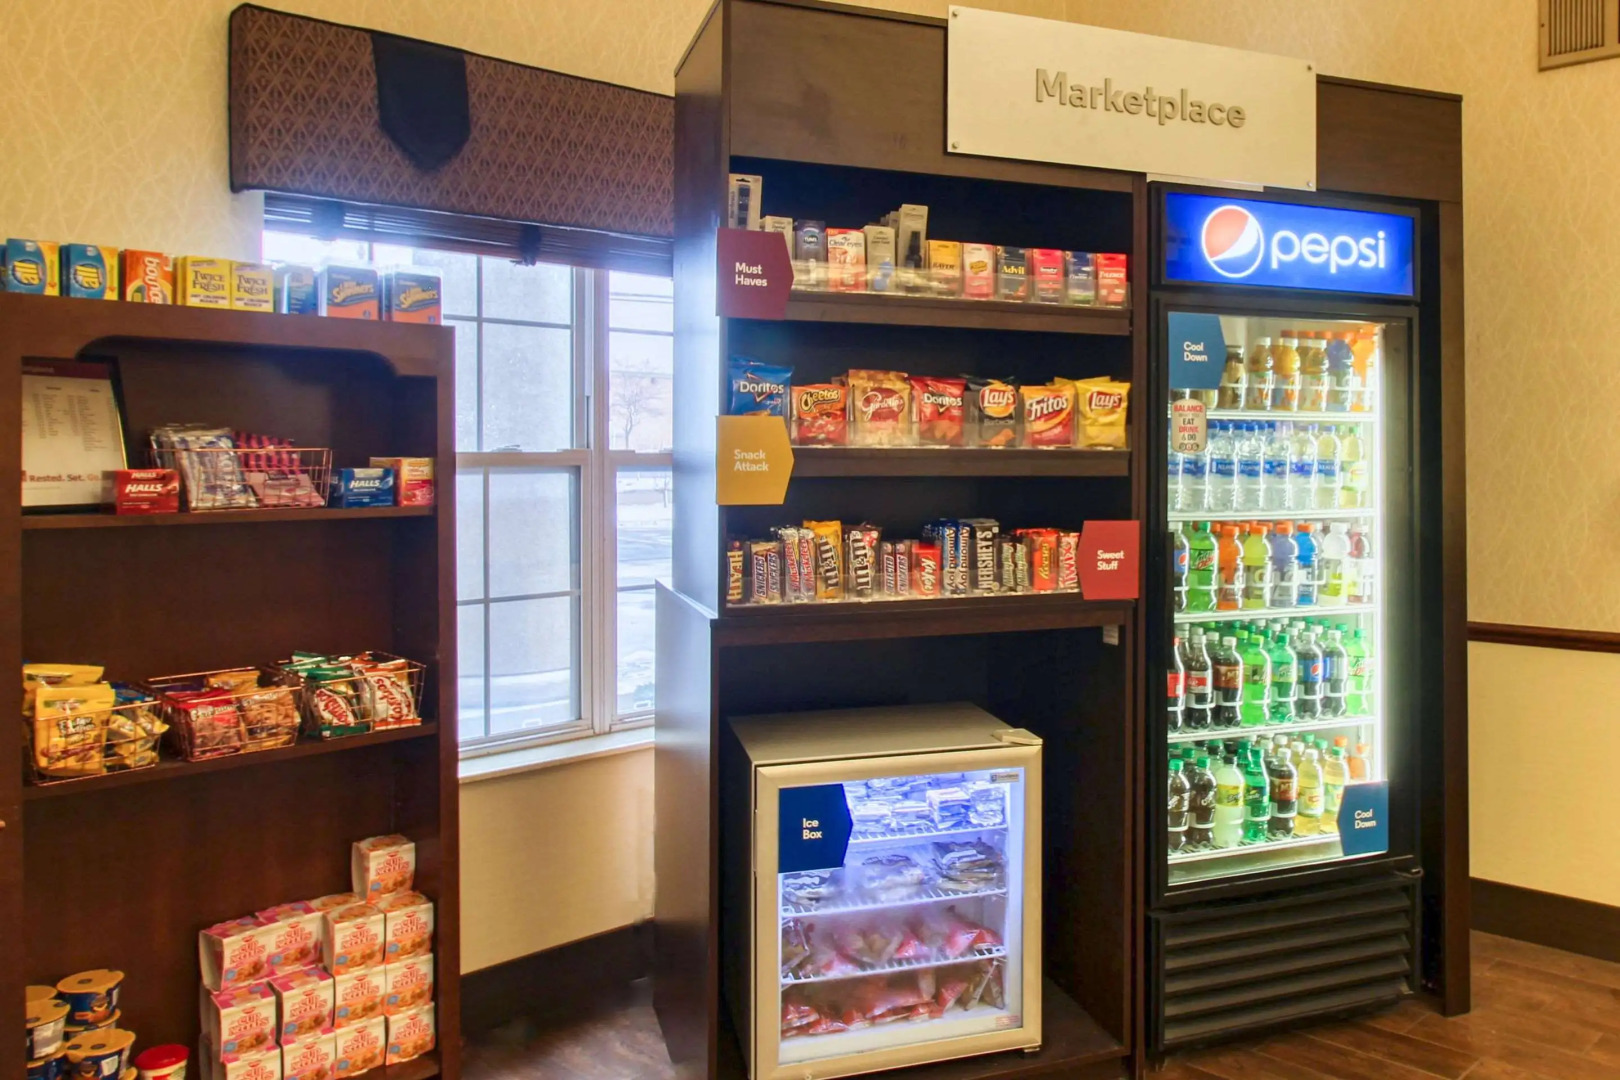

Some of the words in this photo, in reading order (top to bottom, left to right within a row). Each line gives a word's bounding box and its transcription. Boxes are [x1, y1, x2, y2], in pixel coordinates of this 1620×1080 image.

[1035, 67, 1247, 128] Marketplace
[829, 239, 845, 247] Clear
[1270, 229, 1386, 274] pepsi
[735, 261, 763, 275] Must
[1002, 265, 1025, 275] Advil
[735, 274, 768, 287] Haves
[1183, 341, 1204, 351] Cool
[1183, 352, 1208, 362] Down
[739, 381, 785, 394] Doritos
[800, 388, 842, 412] Cheetos
[923, 392, 963, 407] Doritos
[1026, 395, 1068, 421] Fritos
[1173, 404, 1204, 412] BALANCE
[1182, 418, 1195, 426] EAT
[1178, 425, 1199, 433] DRINK
[1187, 433, 1197, 441] DO
[734, 449, 766, 460] Snack
[733, 461, 769, 472] Attack
[67, 474, 85, 482] Set.
[125, 483, 163, 493] HALLS
[349, 480, 380, 489] HALLS
[959, 526, 970, 568] Almond
[1097, 550, 1125, 560] Sweet
[1097, 561, 1119, 571] Stuff
[726, 551, 744, 600] HEATH
[754, 556, 767, 597] SNICKERS
[767, 552, 779, 594] SNICKERS
[1355, 809, 1373, 819] Cool
[802, 818, 819, 829] Ice
[1355, 819, 1376, 829] Down
[802, 828, 823, 840] Box
